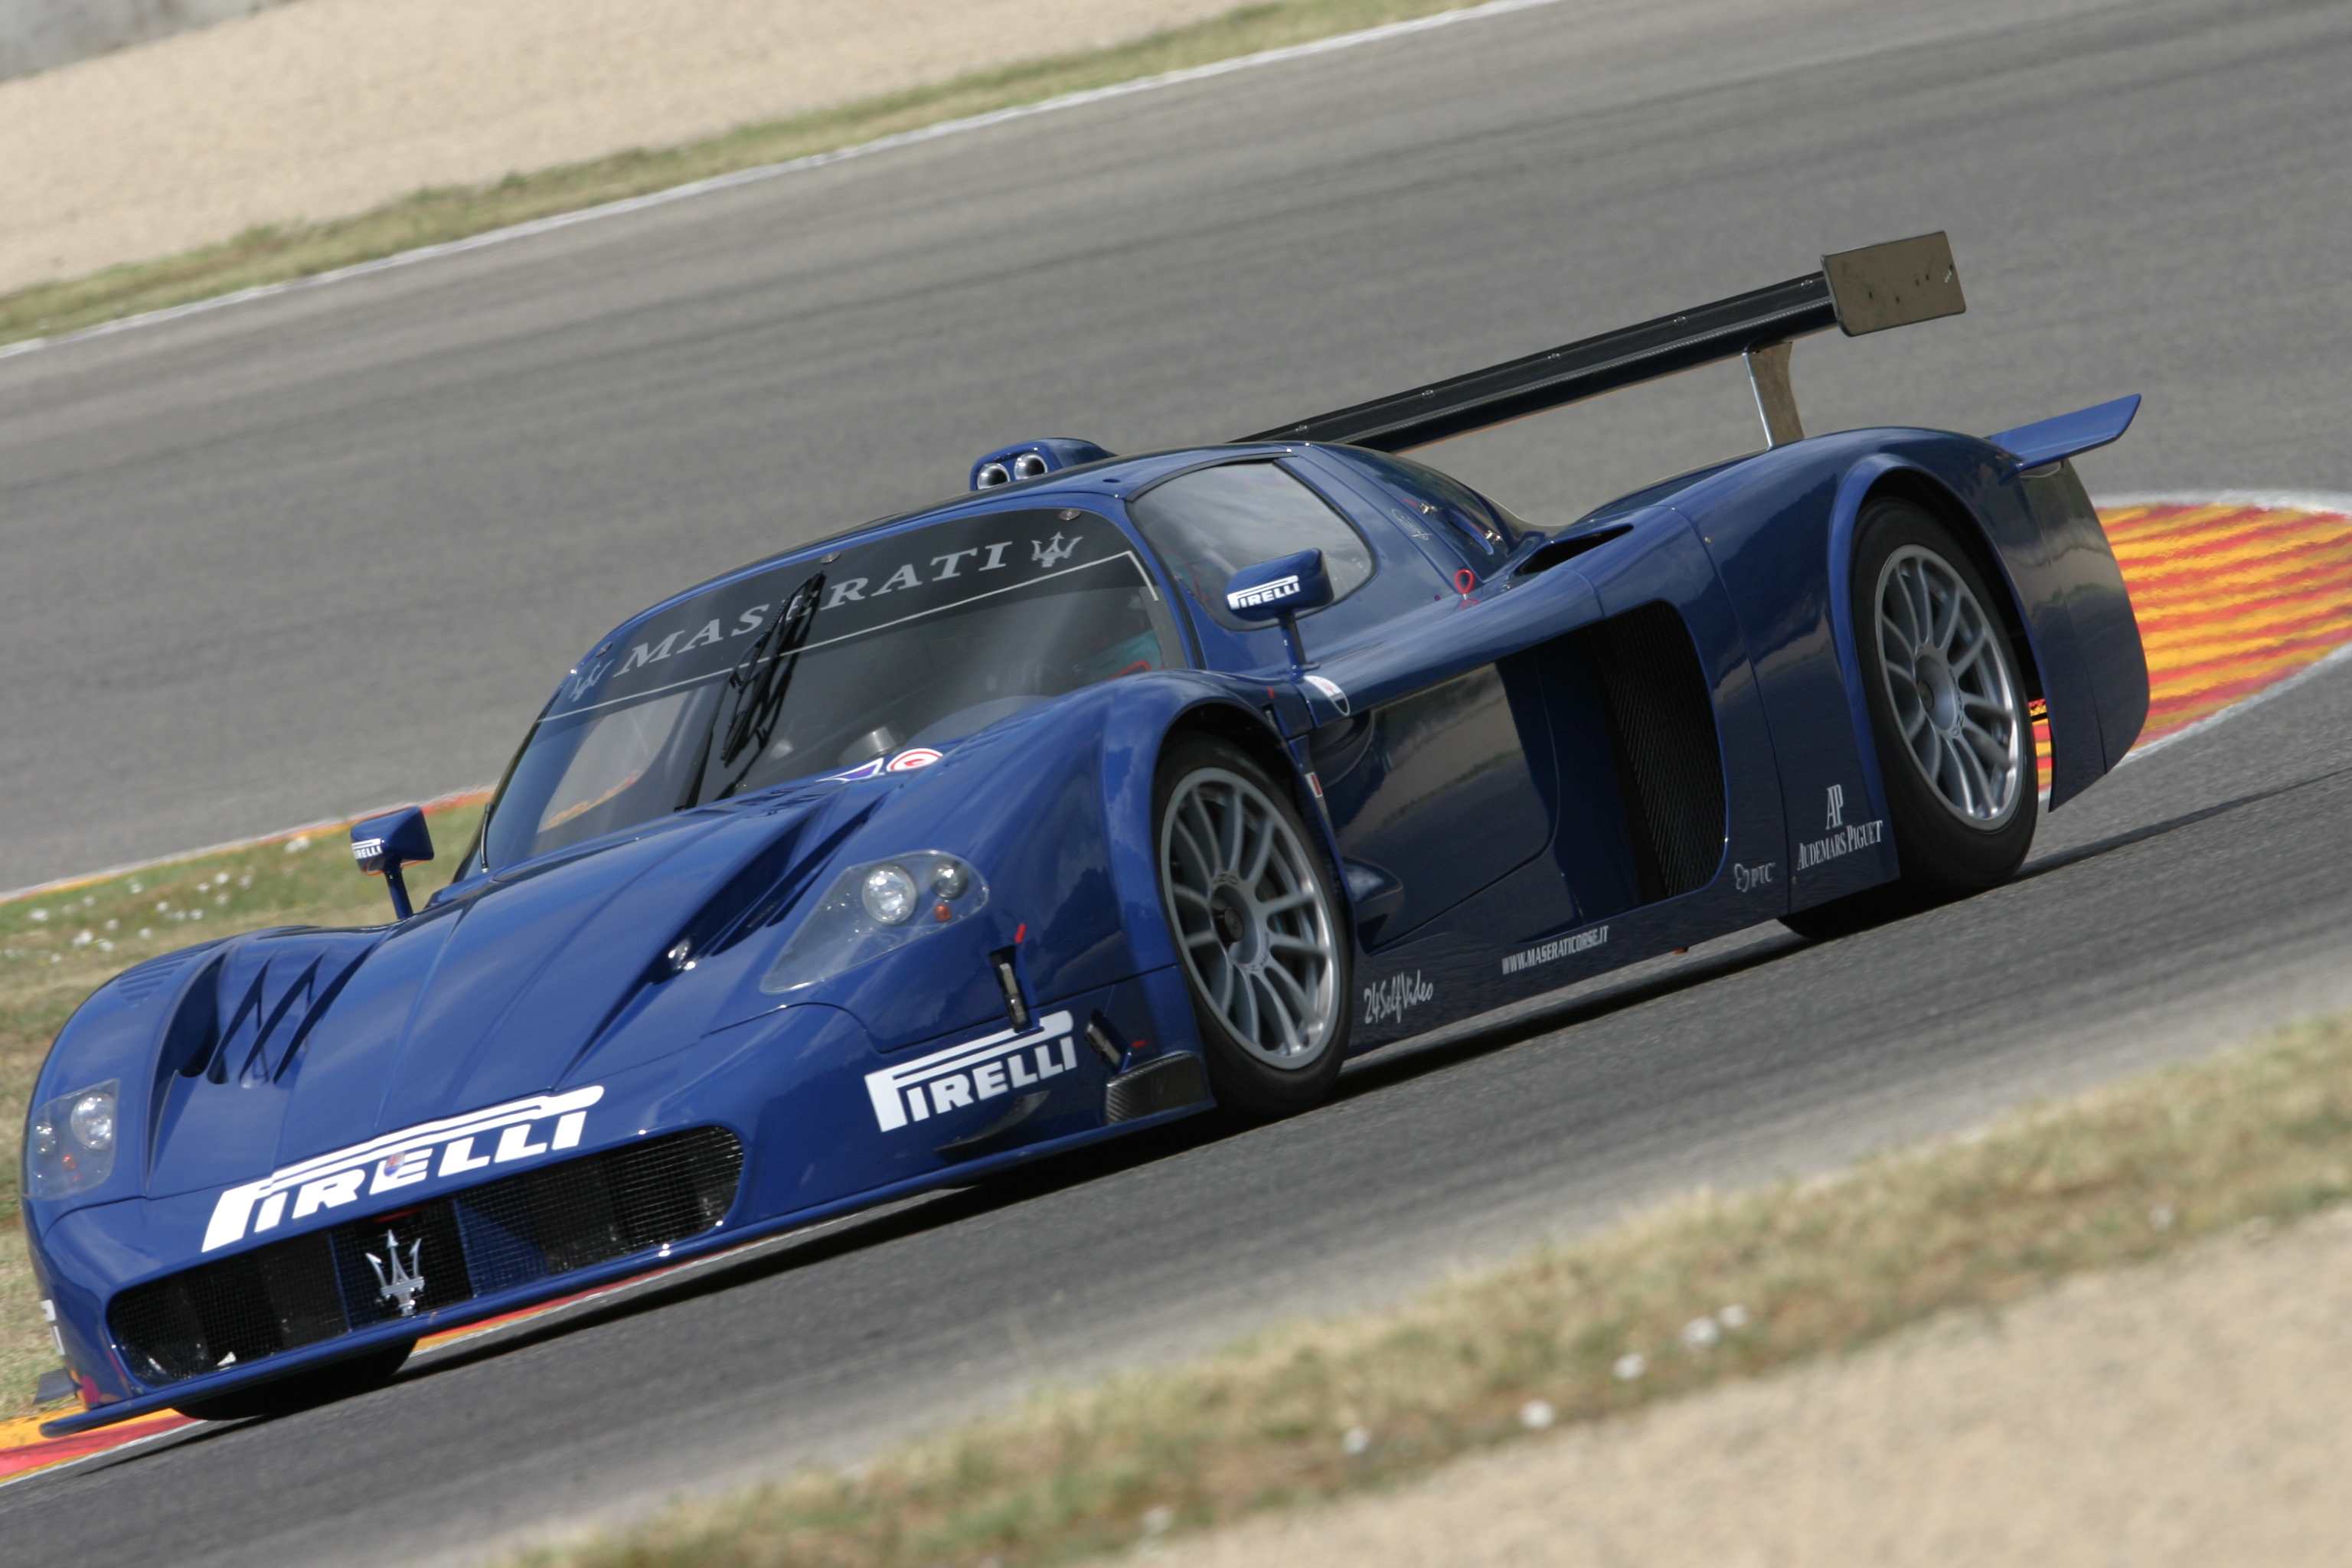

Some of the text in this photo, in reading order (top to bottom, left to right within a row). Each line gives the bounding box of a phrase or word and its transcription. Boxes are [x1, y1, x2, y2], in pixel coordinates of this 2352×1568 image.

[1227, 574, 1301, 610] PIRELLI
[1825, 784, 1844, 830] AP
[1797, 820, 1883, 871] AUDEMARS PIGUET
[1751, 863, 1774, 887] PTC
[1501, 925, 1609, 975] WWW.MASERATICORSE.IT
[864, 1009, 1078, 1133] PIRELLI
[201, 1085, 605, 1253] PIRELLI
